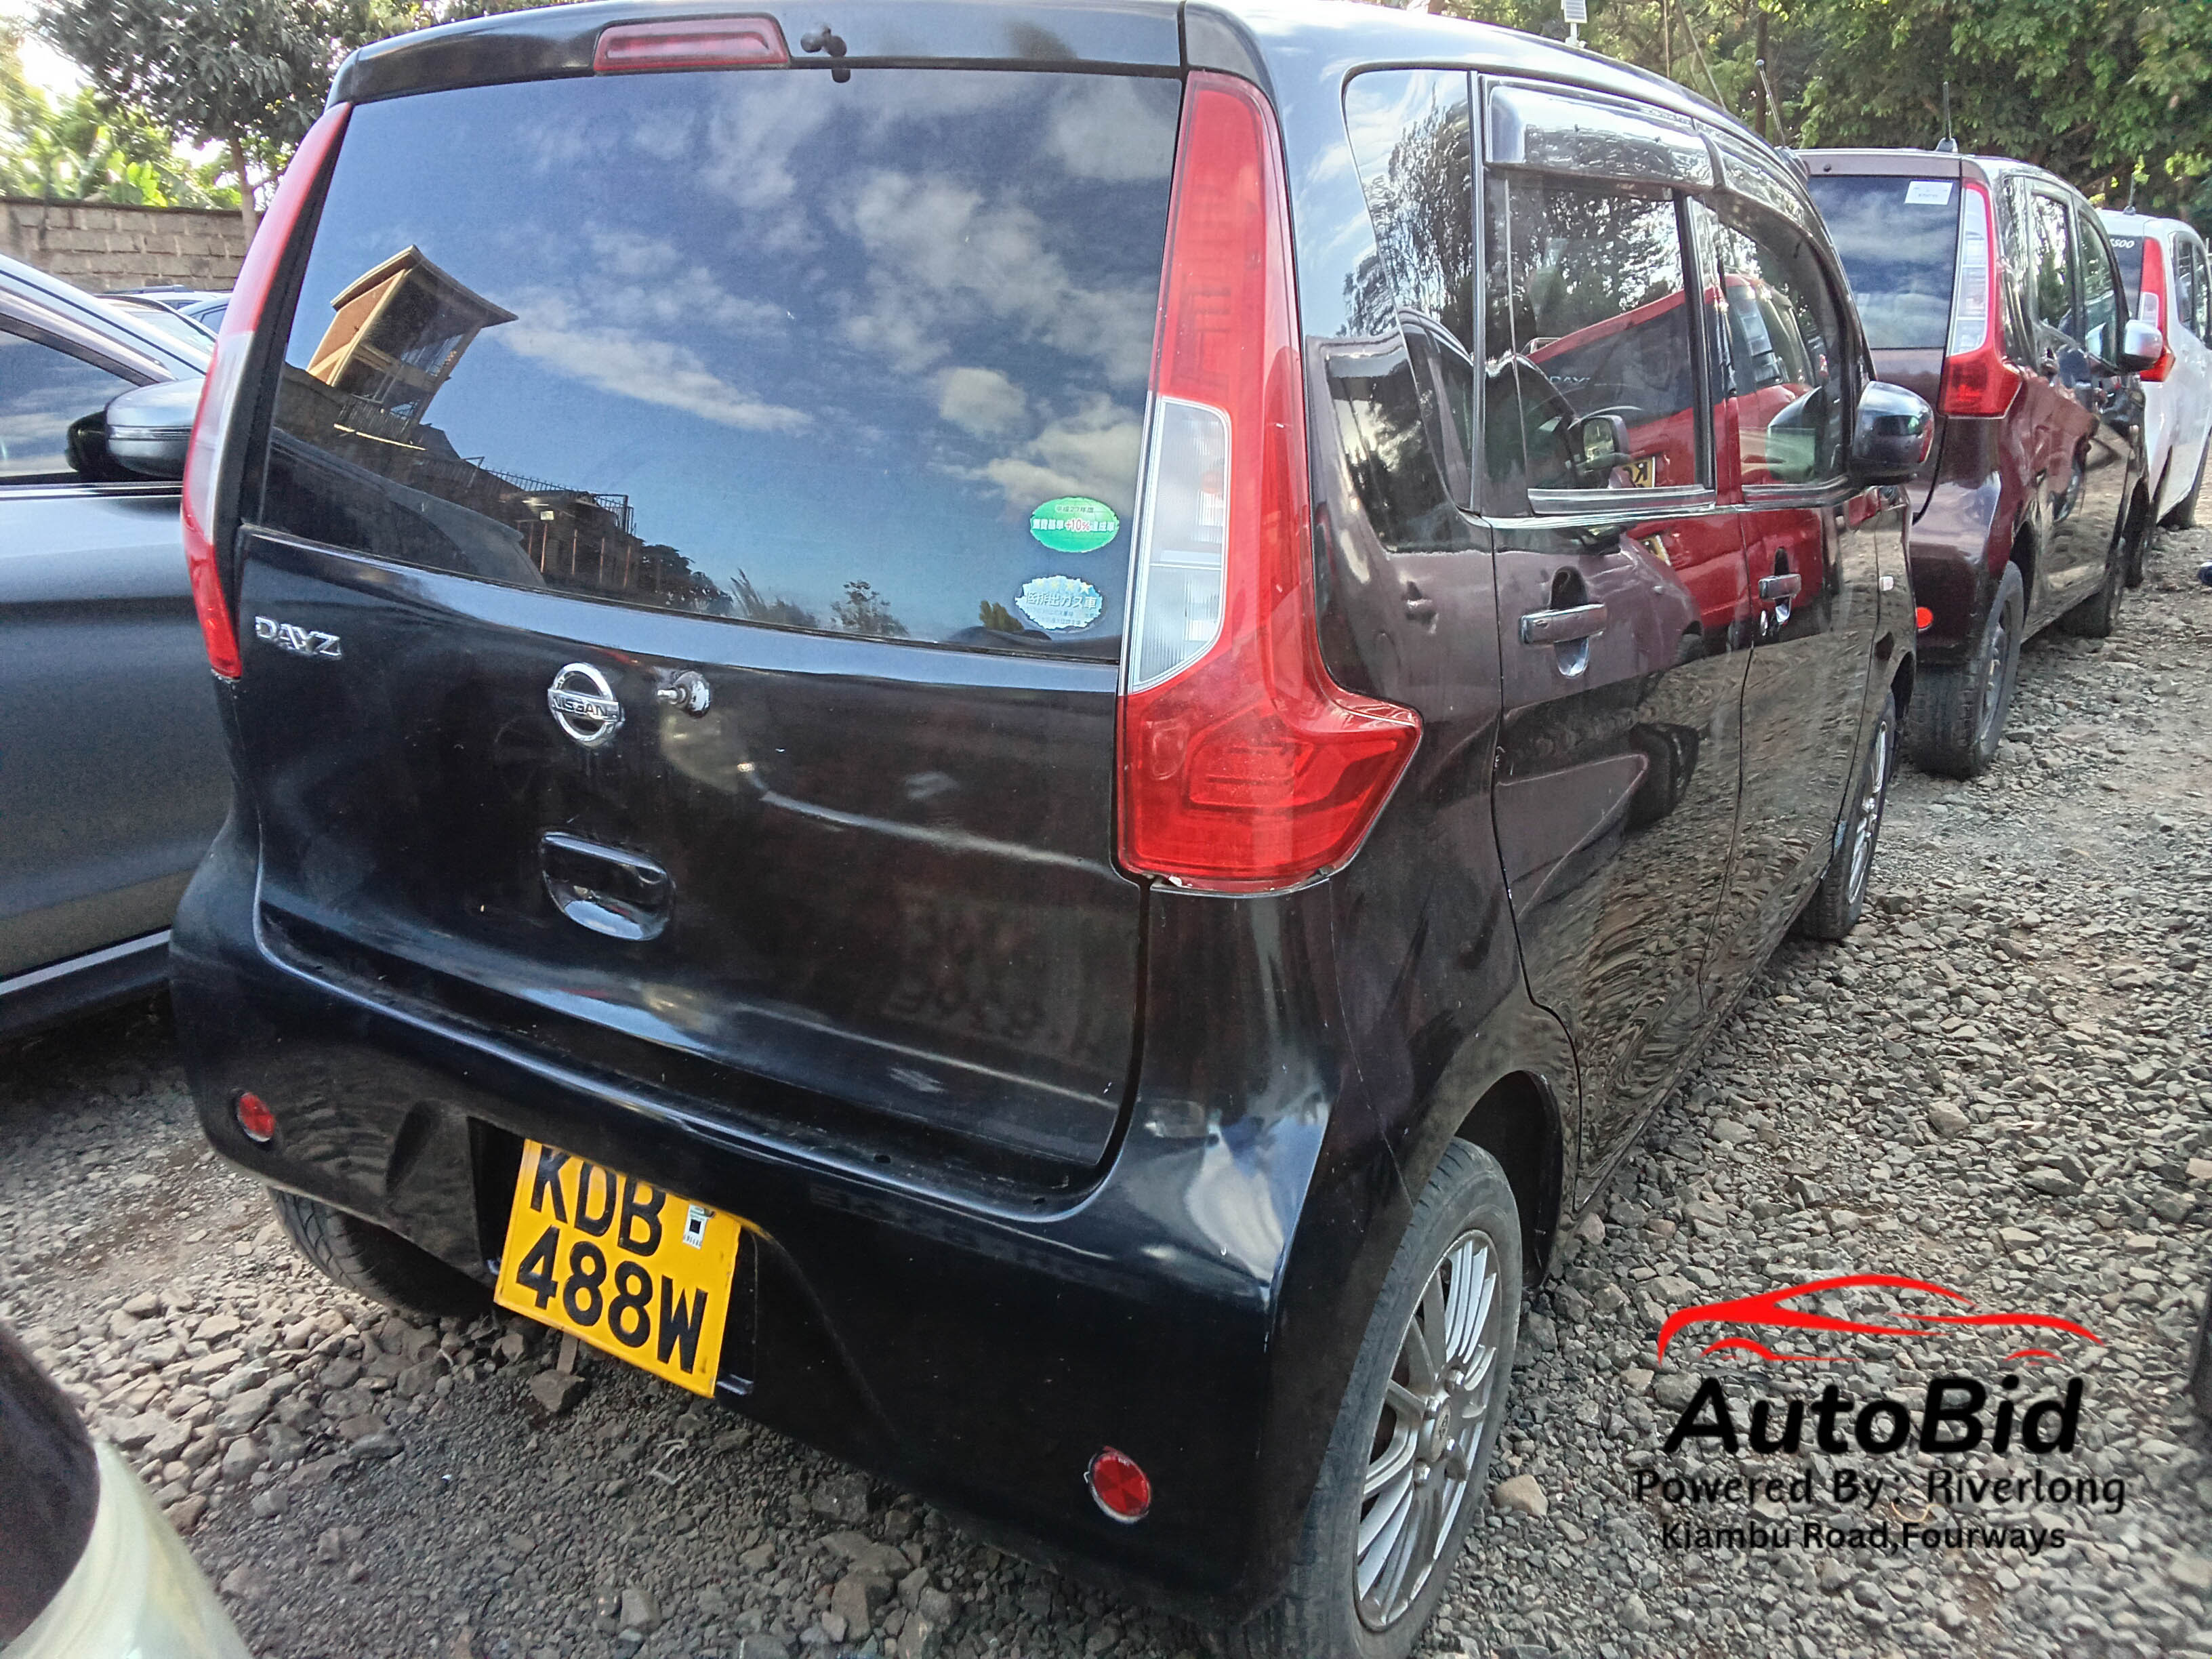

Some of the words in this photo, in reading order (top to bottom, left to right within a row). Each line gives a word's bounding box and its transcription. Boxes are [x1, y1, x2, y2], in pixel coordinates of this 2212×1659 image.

[255, 615, 342, 659] DAYZ
[552, 697, 609, 720] NISSAN
[530, 1145, 666, 1256] KDB
[516, 1225, 708, 1374] 488W
